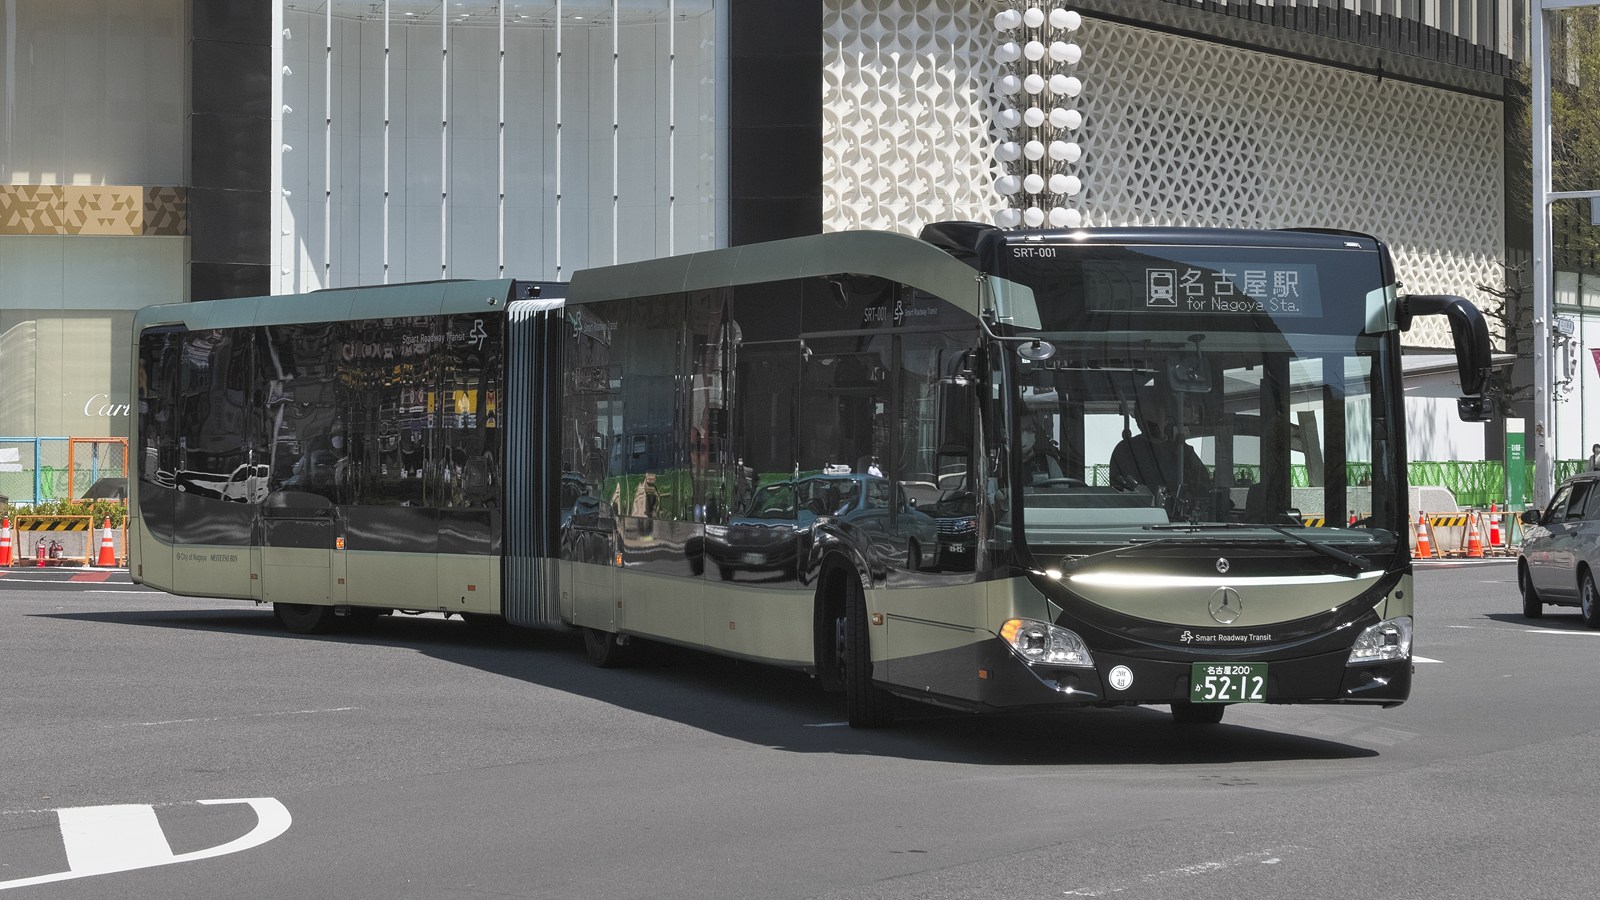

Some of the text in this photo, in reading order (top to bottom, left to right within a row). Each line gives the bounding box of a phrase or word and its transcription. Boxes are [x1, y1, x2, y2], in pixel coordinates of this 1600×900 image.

[1013, 247, 1057, 258] SRT-001
[1179, 268, 1299, 297] 名古屋駅
[1186, 296, 1300, 312] for Nagoya Sta.
[864, 306, 887, 322] SRT-001
[402, 332, 465, 344] Smart Roadway Transit
[1195, 634, 1216, 642] Smart
[1218, 633, 1248, 643] Roadway
[1249, 633, 1272, 641] Transit
[1207, 665, 1250, 675] 名古屋200
[1204, 675, 1264, 700] 52-12
